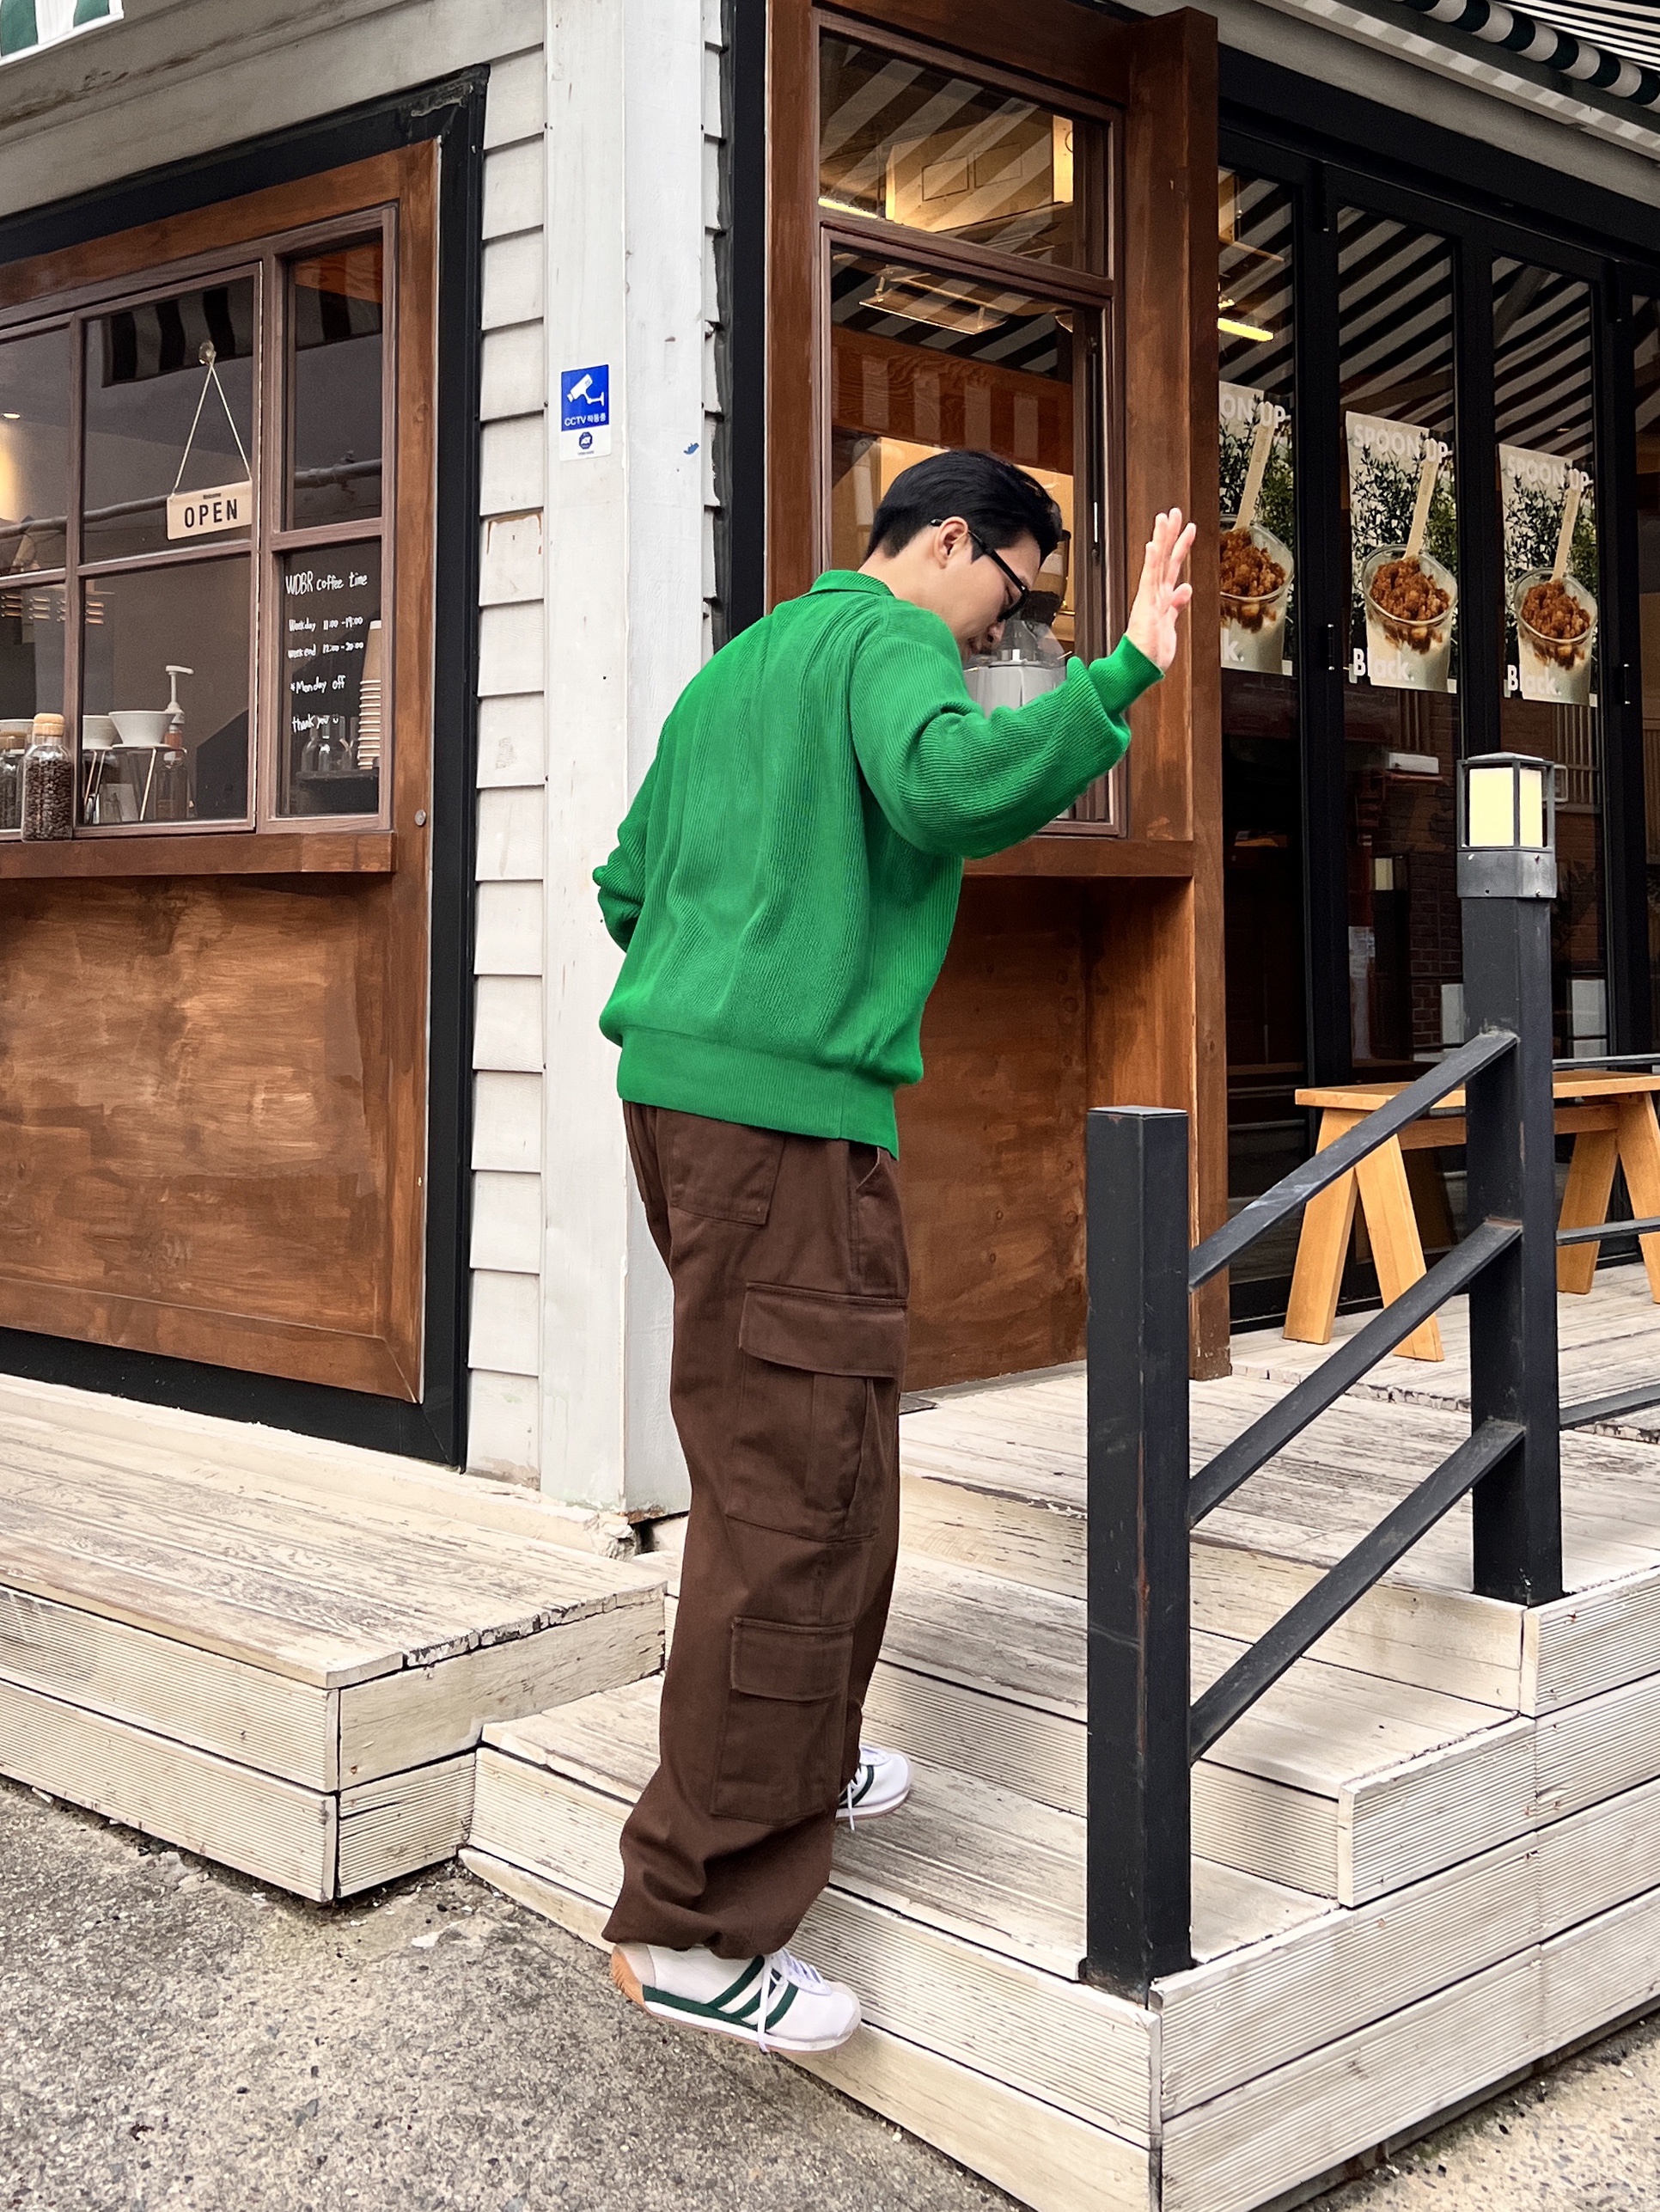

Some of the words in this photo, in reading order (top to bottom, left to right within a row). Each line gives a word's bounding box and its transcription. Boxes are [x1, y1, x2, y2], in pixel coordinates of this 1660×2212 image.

[564, 415, 587, 427] CCTV
[1353, 424, 1423, 461] SPOON
[1507, 455, 1565, 488] SPOON
[185, 498, 237, 529] OPEN
[285, 570, 314, 596] WDBR
[316, 574, 345, 591] coffee
[348, 571, 368, 588] time
[332, 675, 346, 690] off
[291, 712, 315, 734] thank
[316, 714, 330, 730] you
